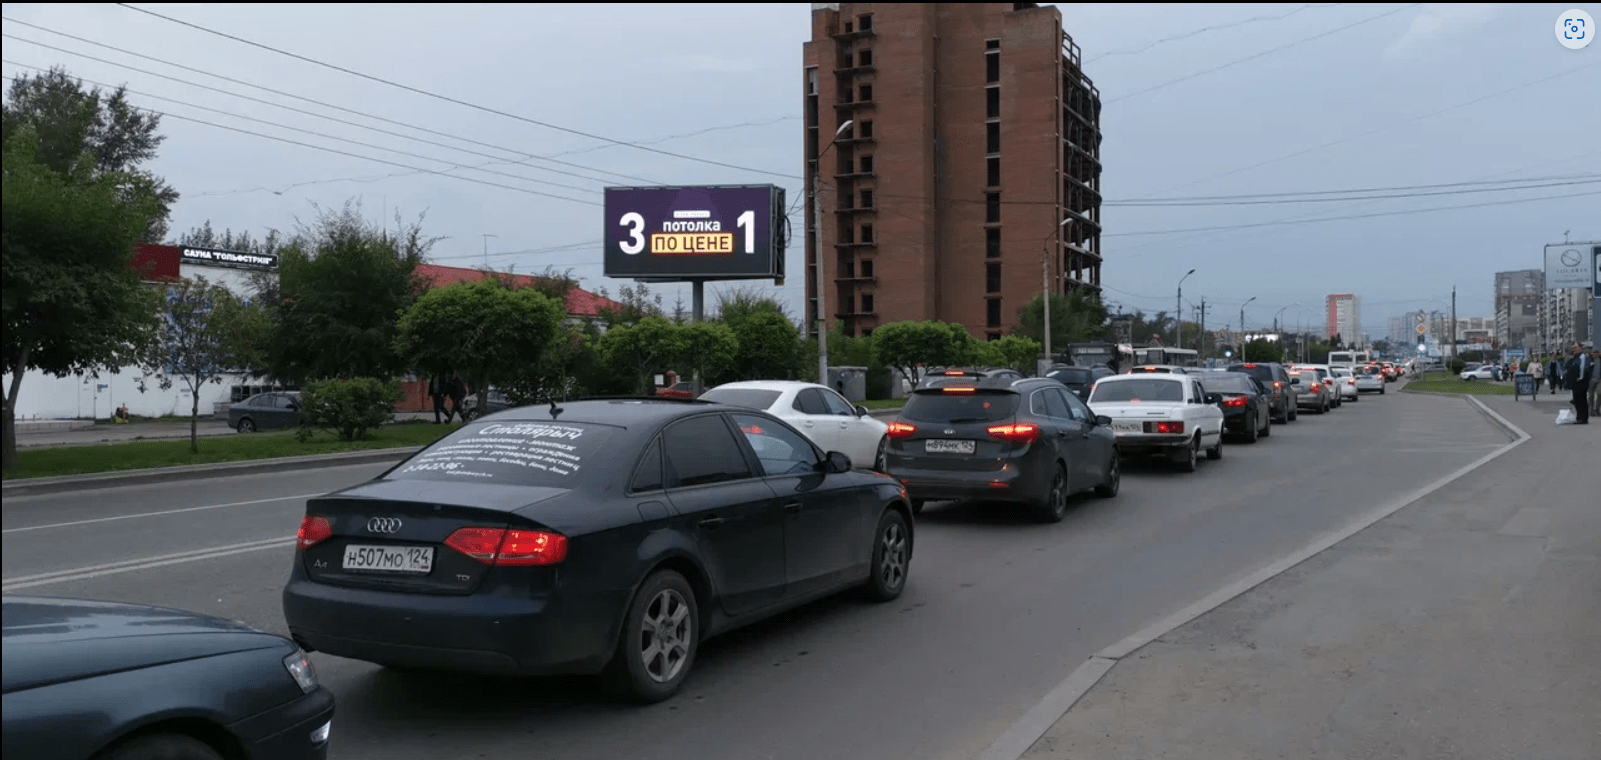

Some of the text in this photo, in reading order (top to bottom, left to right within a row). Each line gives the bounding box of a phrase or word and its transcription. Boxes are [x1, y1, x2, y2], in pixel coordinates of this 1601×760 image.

[619, 211, 646, 255] 3
[662, 220, 721, 232] потолка
[737, 211, 755, 254] 1
[184, 249, 212, 259] САУНА
[655, 236, 729, 253] ПО ЦЕНЕ
[347, 547, 429, 568] Н507МО 124
